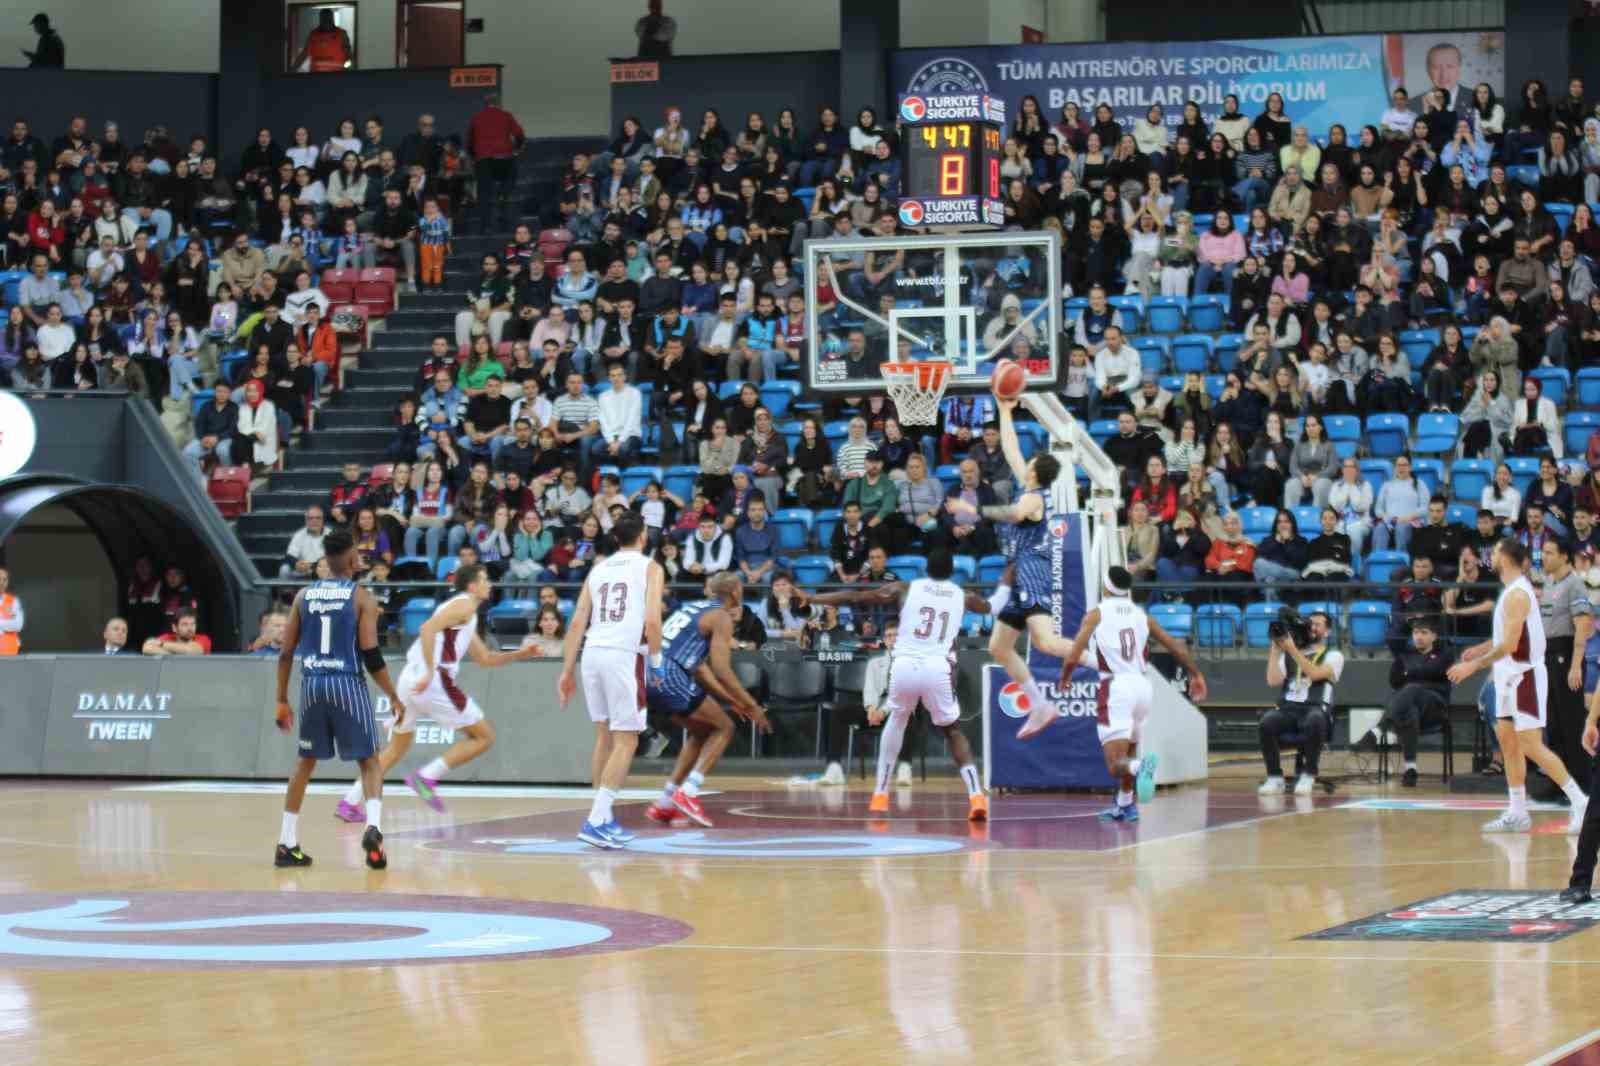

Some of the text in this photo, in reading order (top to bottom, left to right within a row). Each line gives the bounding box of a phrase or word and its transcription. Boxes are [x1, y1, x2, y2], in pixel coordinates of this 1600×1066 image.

[998, 51, 1372, 80] TÜM ANTRENÖR VE SPORCULARIMIZA
[1050, 78, 1327, 112] BAŞARILAR DİLİYORUM
[598, 582, 628, 623] 13
[320, 615, 331, 655] 1
[913, 606, 950, 644] 31
[1119, 627, 1136, 662] 0
[78, 693, 172, 711] DAMAT
